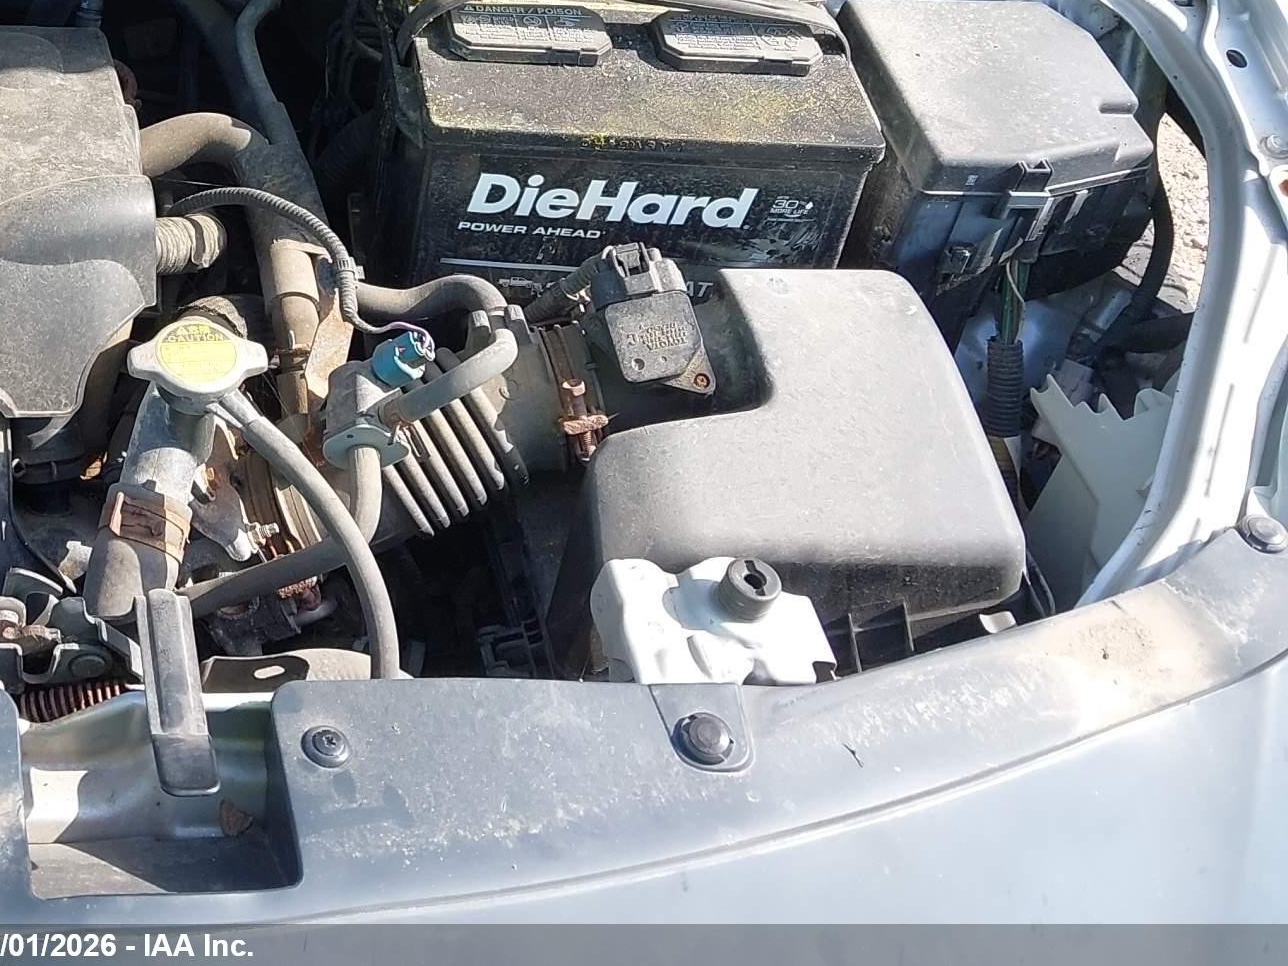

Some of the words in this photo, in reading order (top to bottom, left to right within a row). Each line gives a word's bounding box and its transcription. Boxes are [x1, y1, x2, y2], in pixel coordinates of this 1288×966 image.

[474, 5, 525, 14] DANGER
[537, 7, 583, 16] POISON
[467, 172, 759, 229] DieHard
[457, 221, 527, 235] POWER
[532, 226, 601, 239] AHEAD
[168, 334, 223, 343] CAUTION
